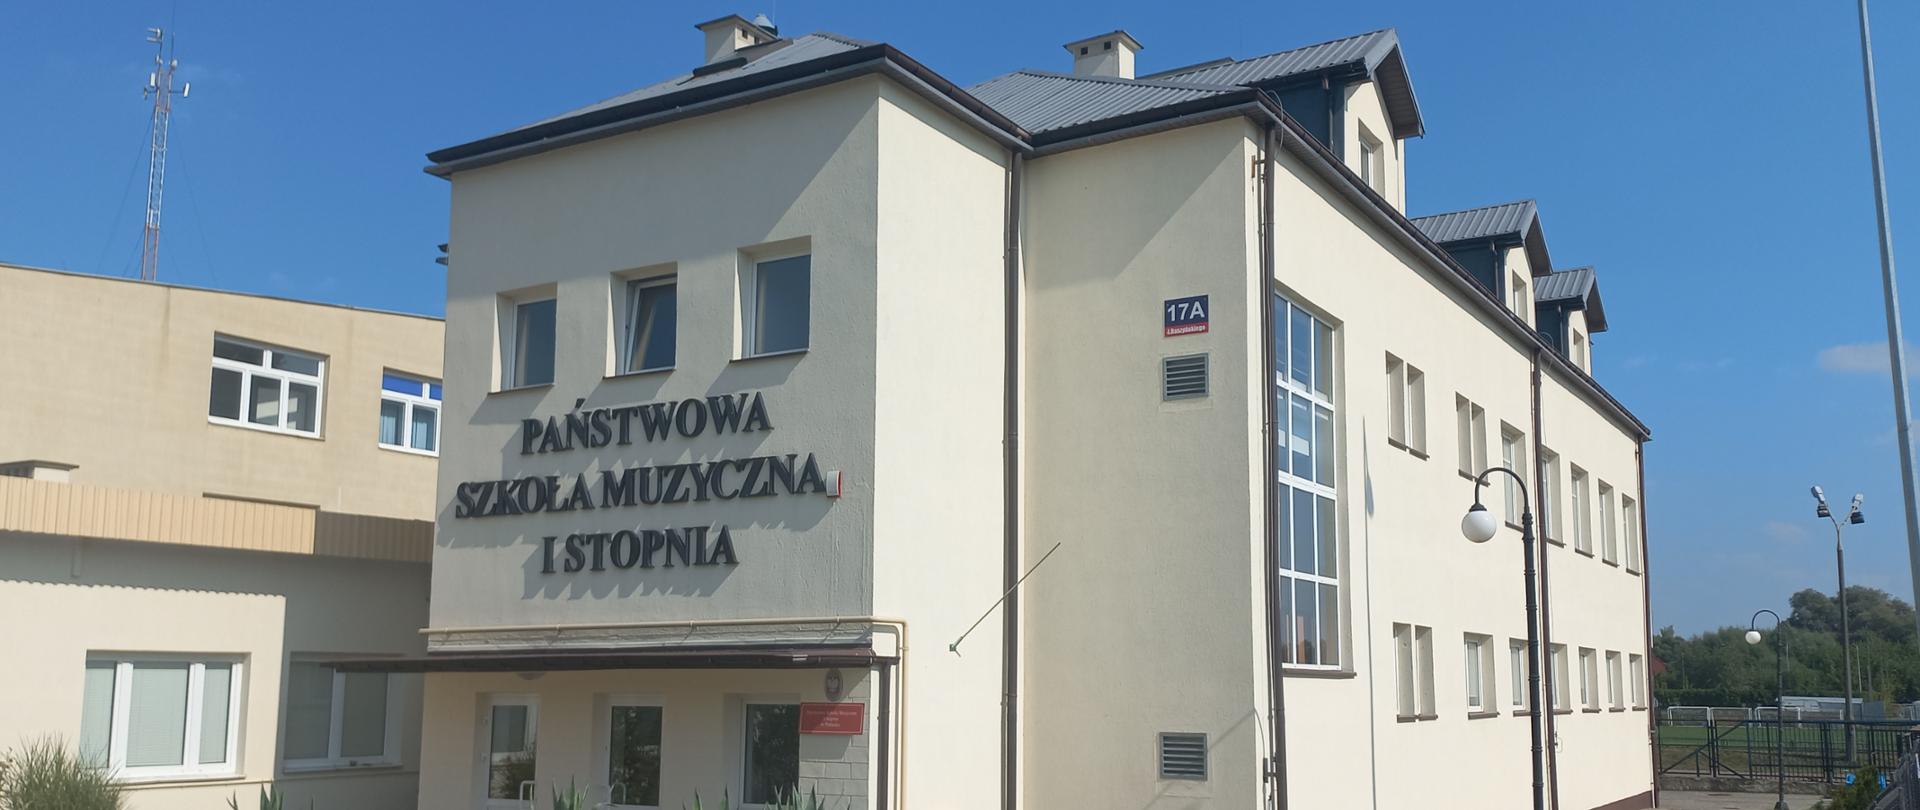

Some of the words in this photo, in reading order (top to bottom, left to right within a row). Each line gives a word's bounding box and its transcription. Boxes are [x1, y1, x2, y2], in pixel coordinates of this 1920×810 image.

[1167, 300, 1205, 322] 17A
[521, 391, 774, 455] PAŃSTWOWA
[455, 471, 595, 519] SZKOŁA
[600, 452, 827, 508] MUZYCZNA
[541, 536, 557, 574] I
[564, 524, 739, 573] STOPNIA
